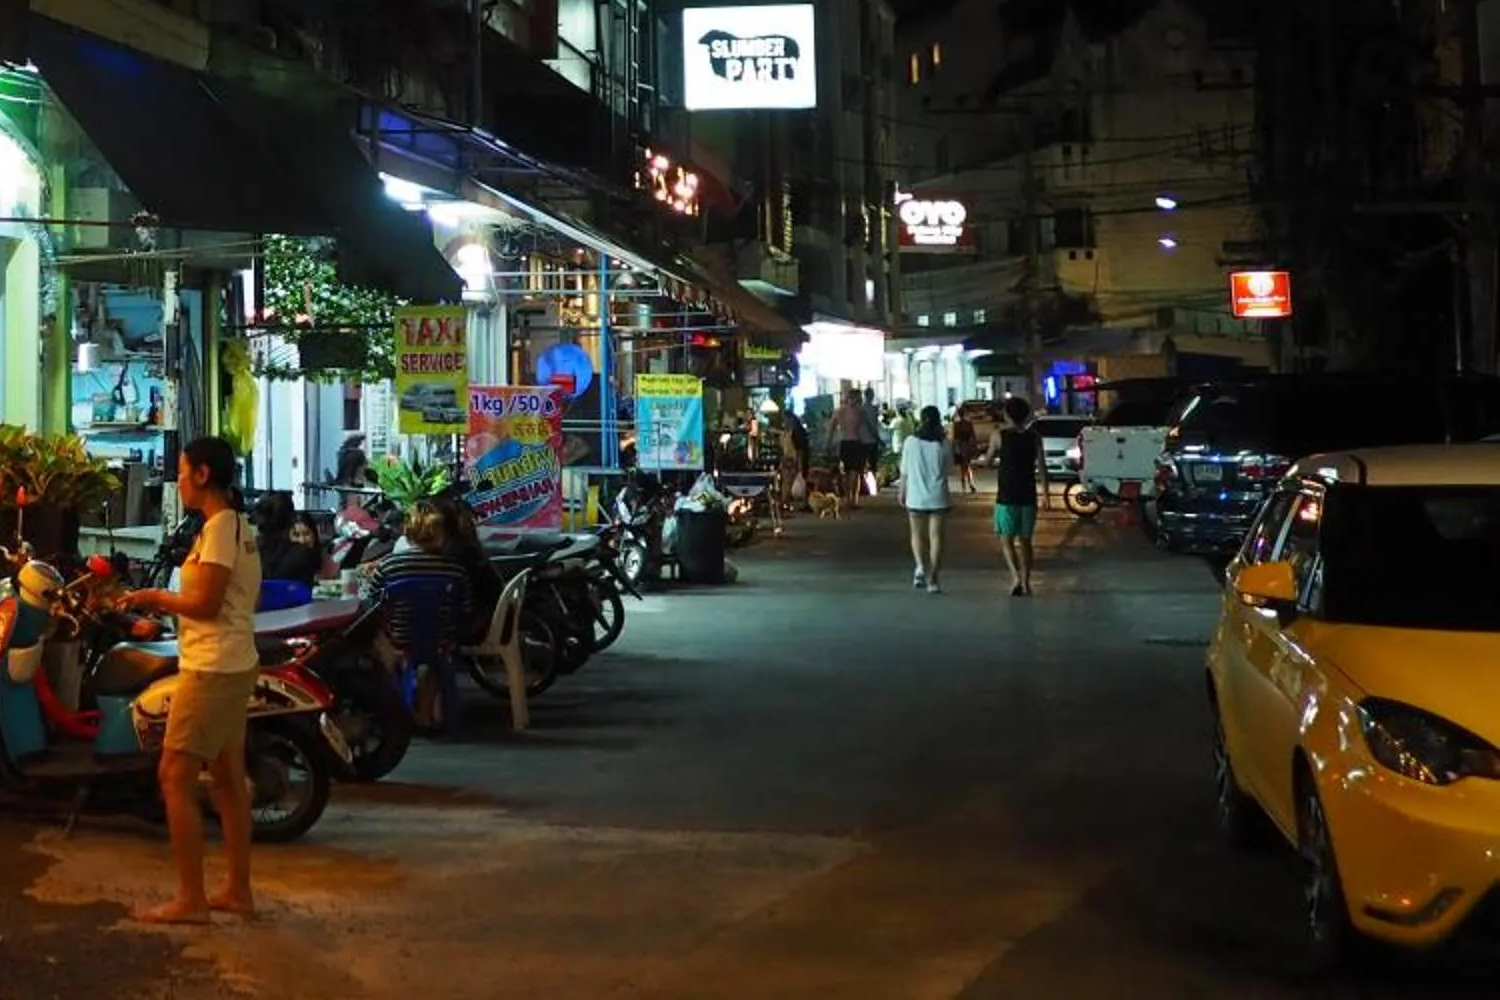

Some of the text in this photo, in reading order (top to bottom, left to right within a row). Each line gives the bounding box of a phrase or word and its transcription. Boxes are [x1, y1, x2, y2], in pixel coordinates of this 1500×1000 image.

[725, 56, 799, 81] PARTY
[900, 200, 967, 226] OYO
[401, 352, 465, 374] SERVICE
[472, 394, 504, 415] 1kg
